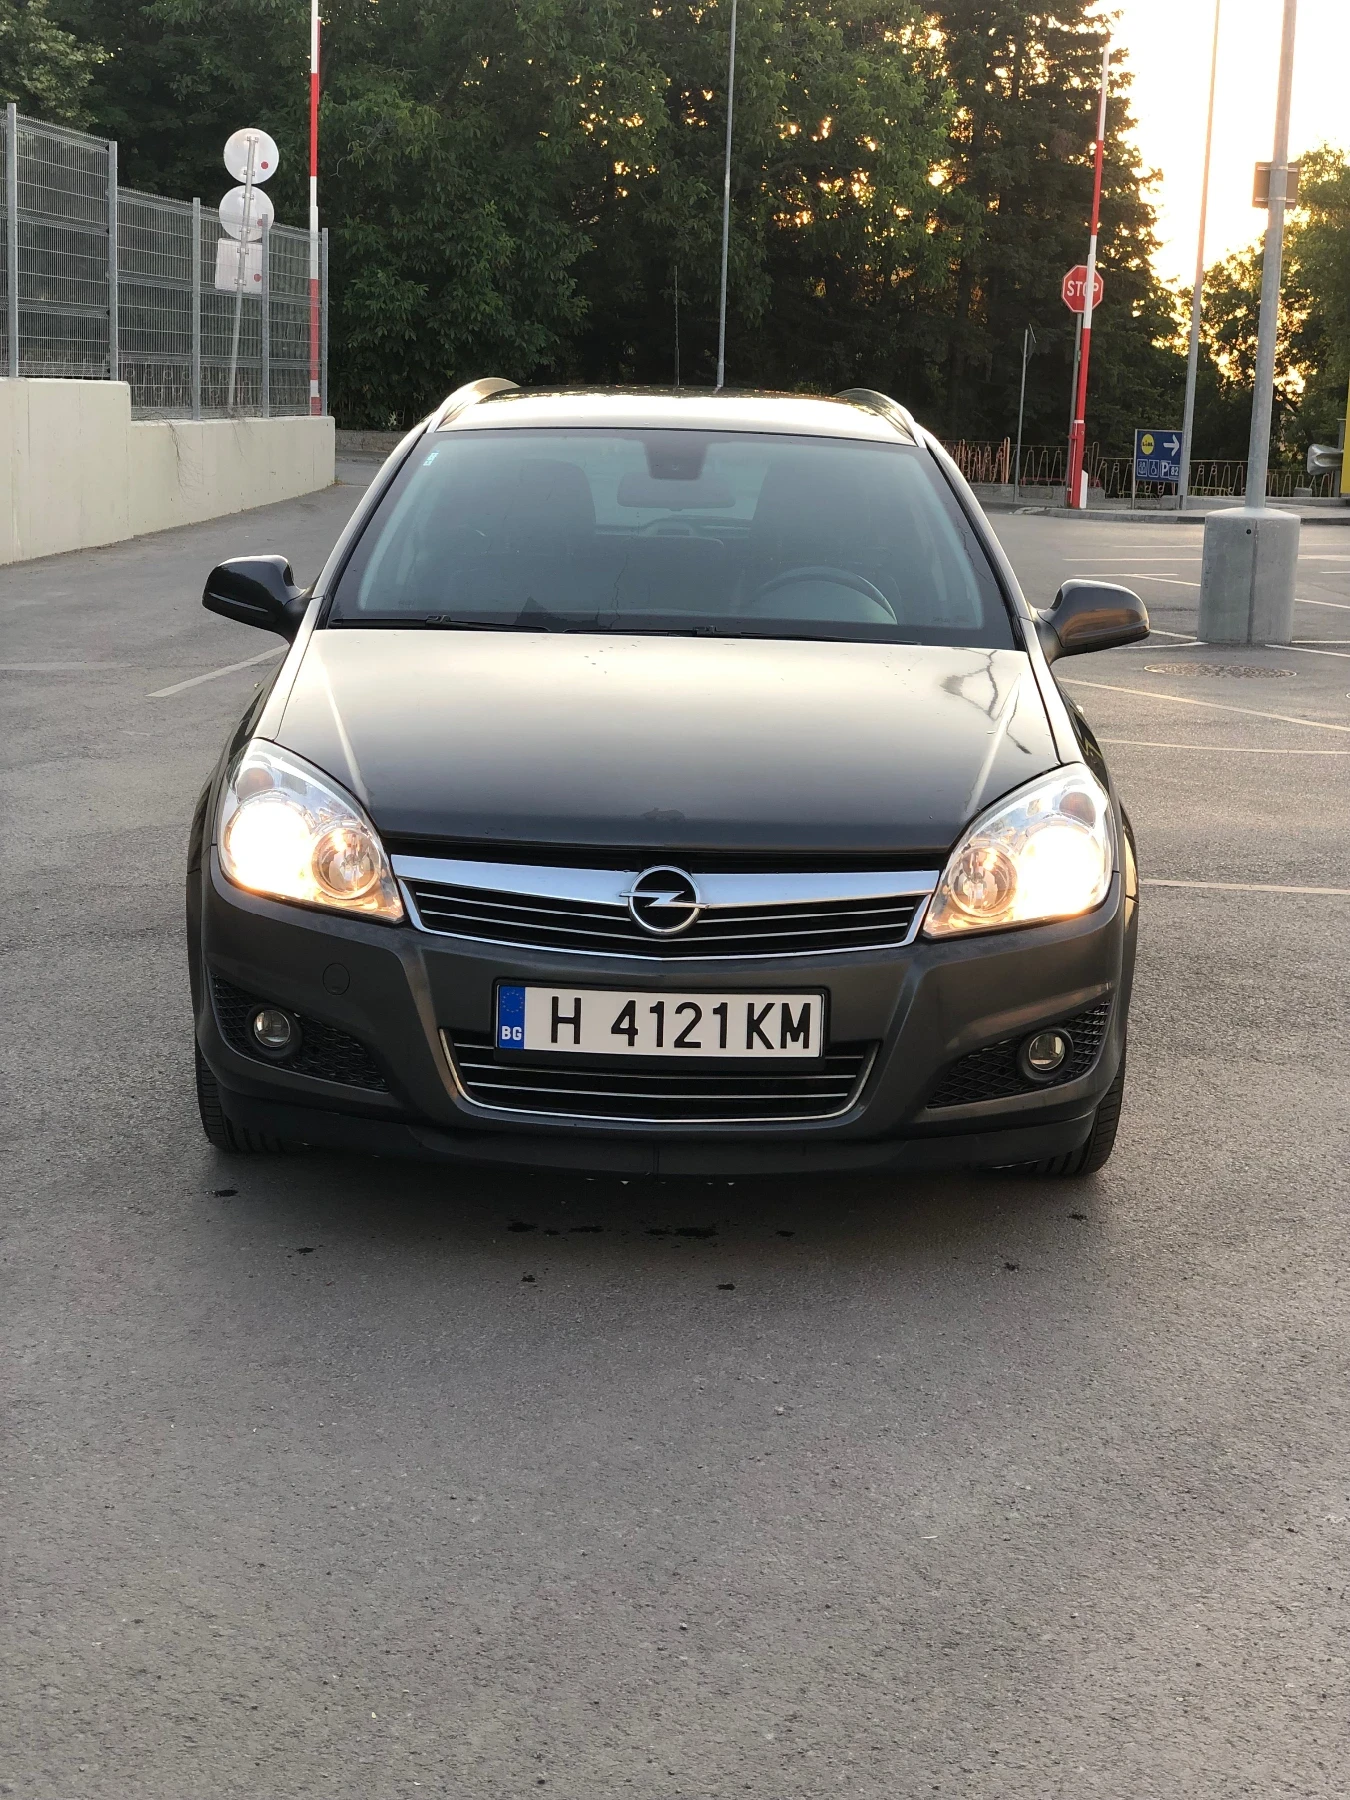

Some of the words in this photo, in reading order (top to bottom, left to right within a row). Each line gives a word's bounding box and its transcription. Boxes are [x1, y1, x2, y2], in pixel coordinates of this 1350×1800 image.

[1161, 462, 1169, 476] P
[550, 996, 582, 1044] H
[611, 1000, 728, 1049] 4121
[746, 1002, 811, 1049] KM
[501, 1025, 522, 1041] BG
